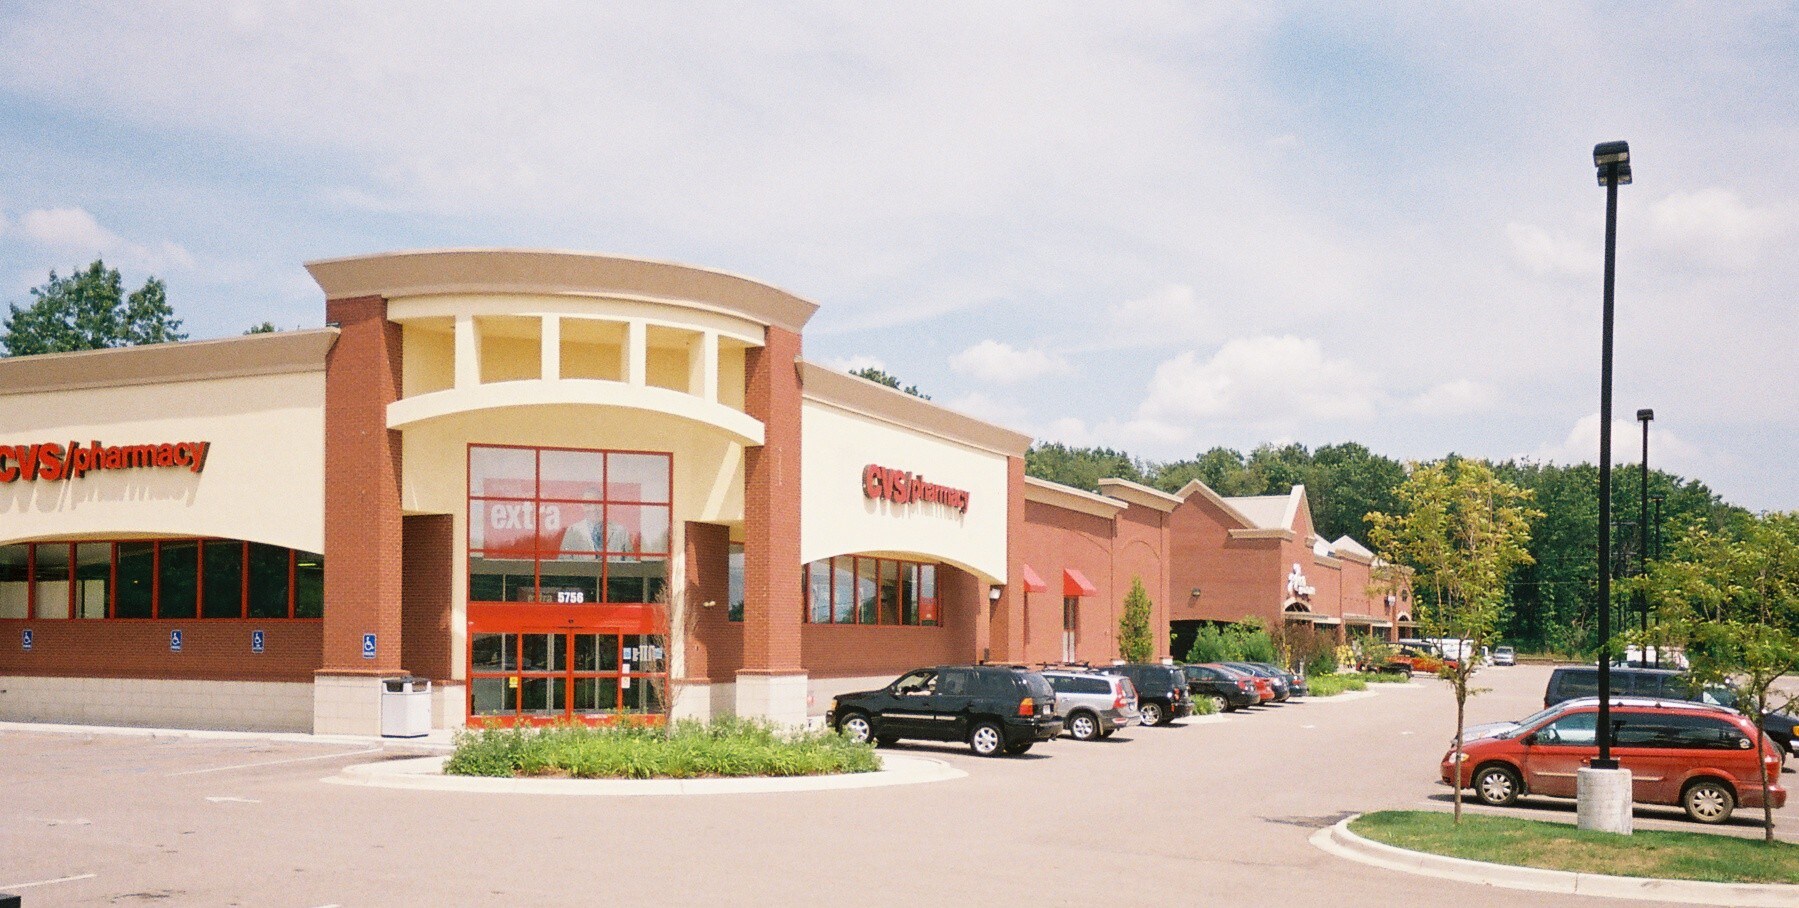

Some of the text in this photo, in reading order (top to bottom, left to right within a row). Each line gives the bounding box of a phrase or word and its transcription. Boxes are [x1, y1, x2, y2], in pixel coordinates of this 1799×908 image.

[0, 440, 208, 482] CVS/pharmacy
[862, 464, 969, 514] CVS/pharmacy
[557, 591, 584, 604] 5756
